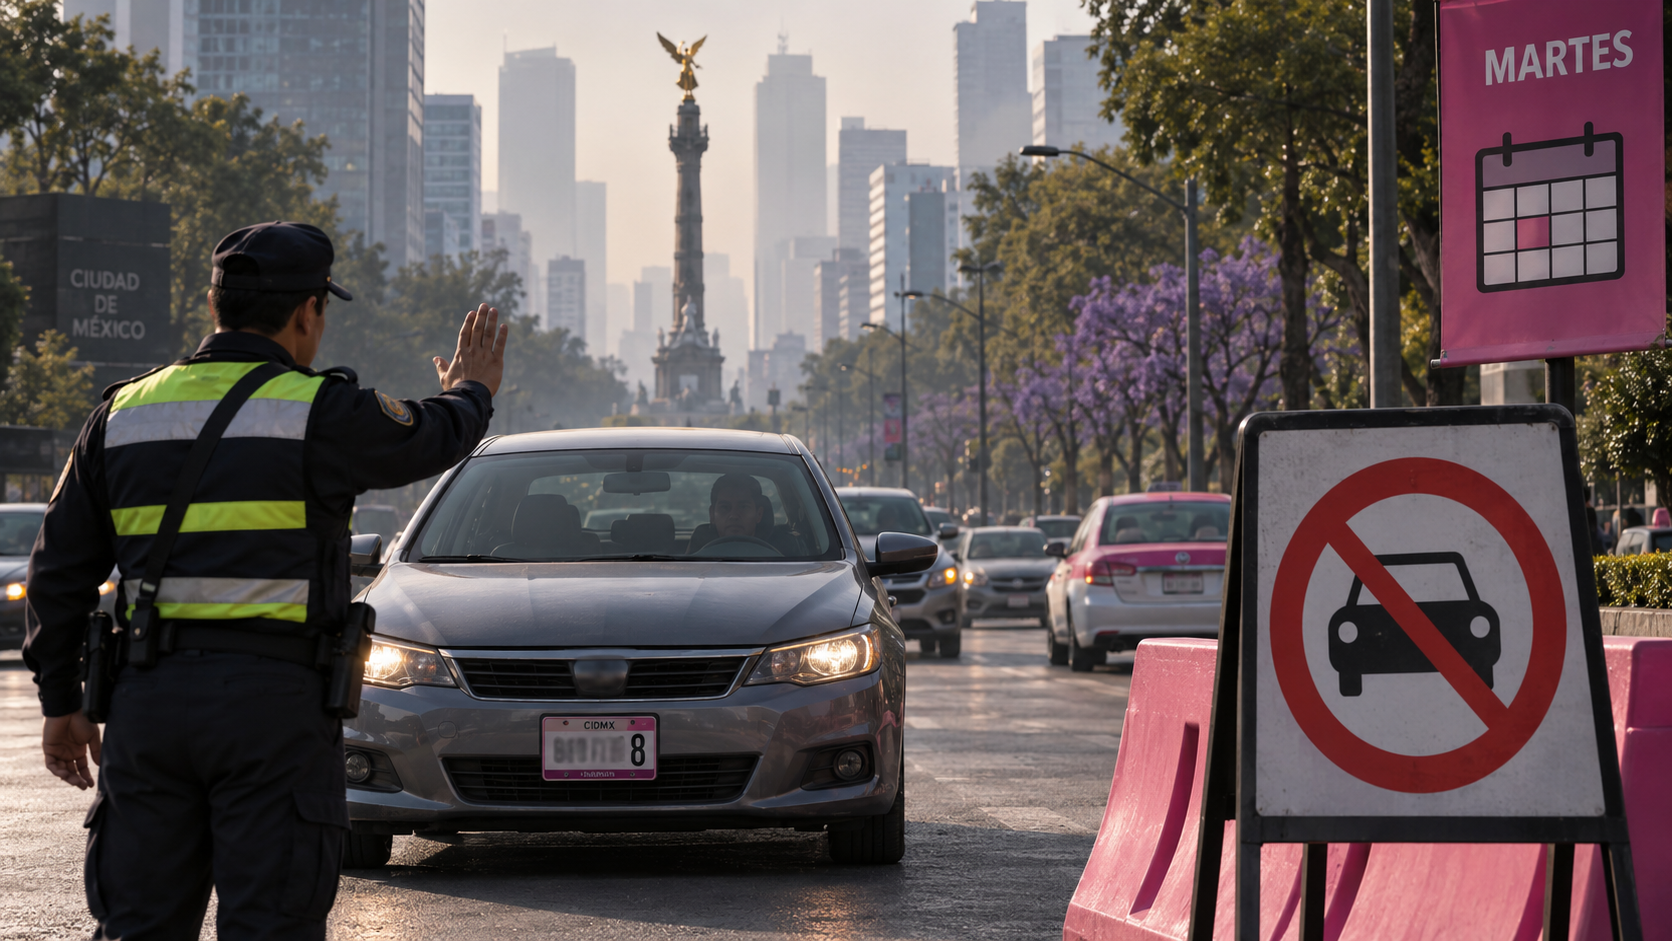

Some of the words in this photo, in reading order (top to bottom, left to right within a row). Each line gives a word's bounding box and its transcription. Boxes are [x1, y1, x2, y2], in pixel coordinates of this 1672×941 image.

[1485, 29, 1634, 86] MARTES
[70, 268, 140, 291] CIUDAD
[94, 294, 118, 314] DE
[72, 314, 146, 340] MÉXICO
[630, 733, 646, 767] 8
